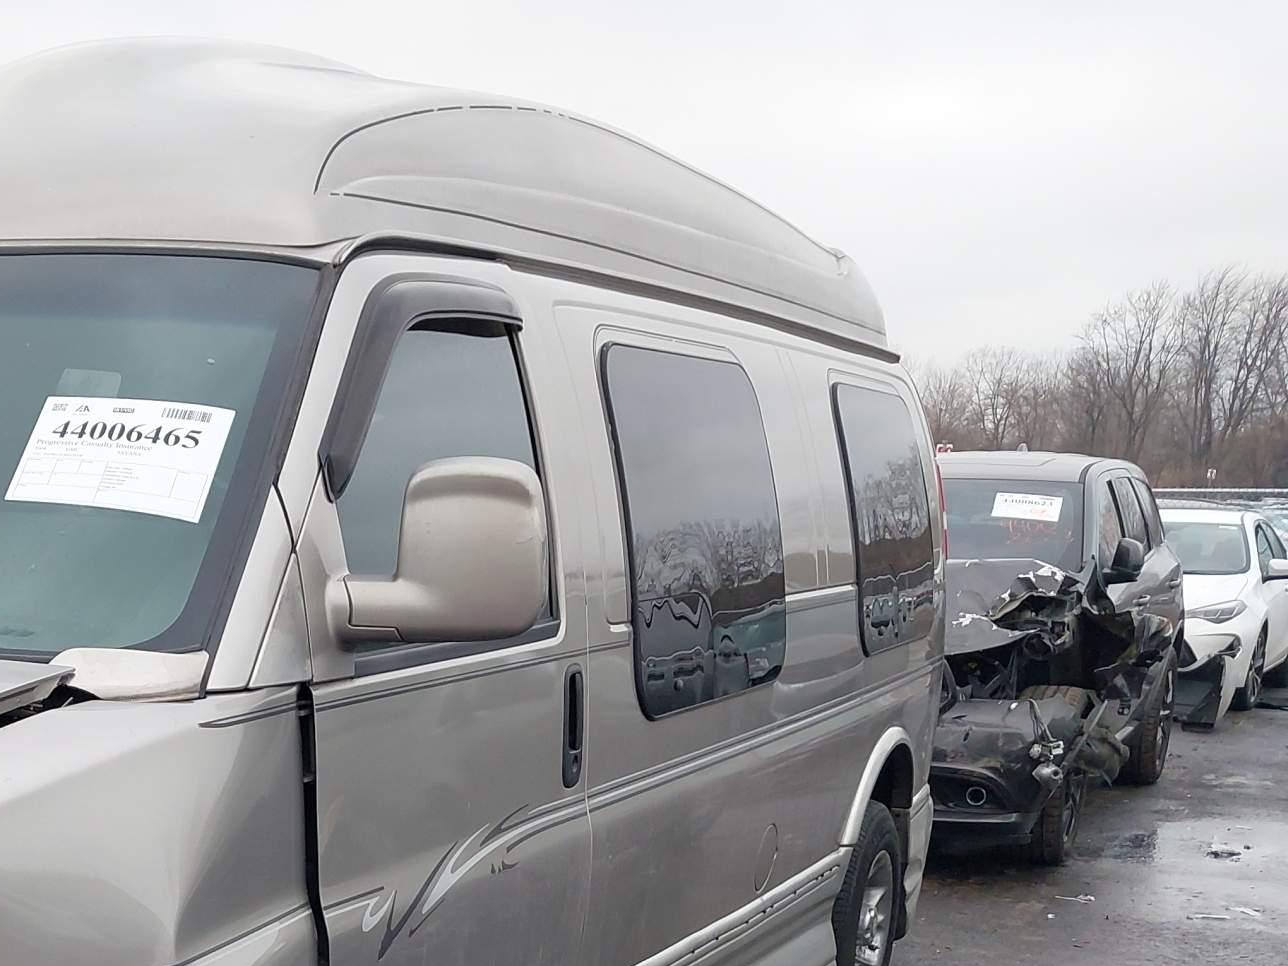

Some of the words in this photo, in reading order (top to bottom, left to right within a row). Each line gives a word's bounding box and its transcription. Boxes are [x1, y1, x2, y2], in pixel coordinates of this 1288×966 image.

[52, 420, 203, 449] 44006465
[81, 440, 113, 449] Casualty
[115, 442, 153, 452] Insurance
